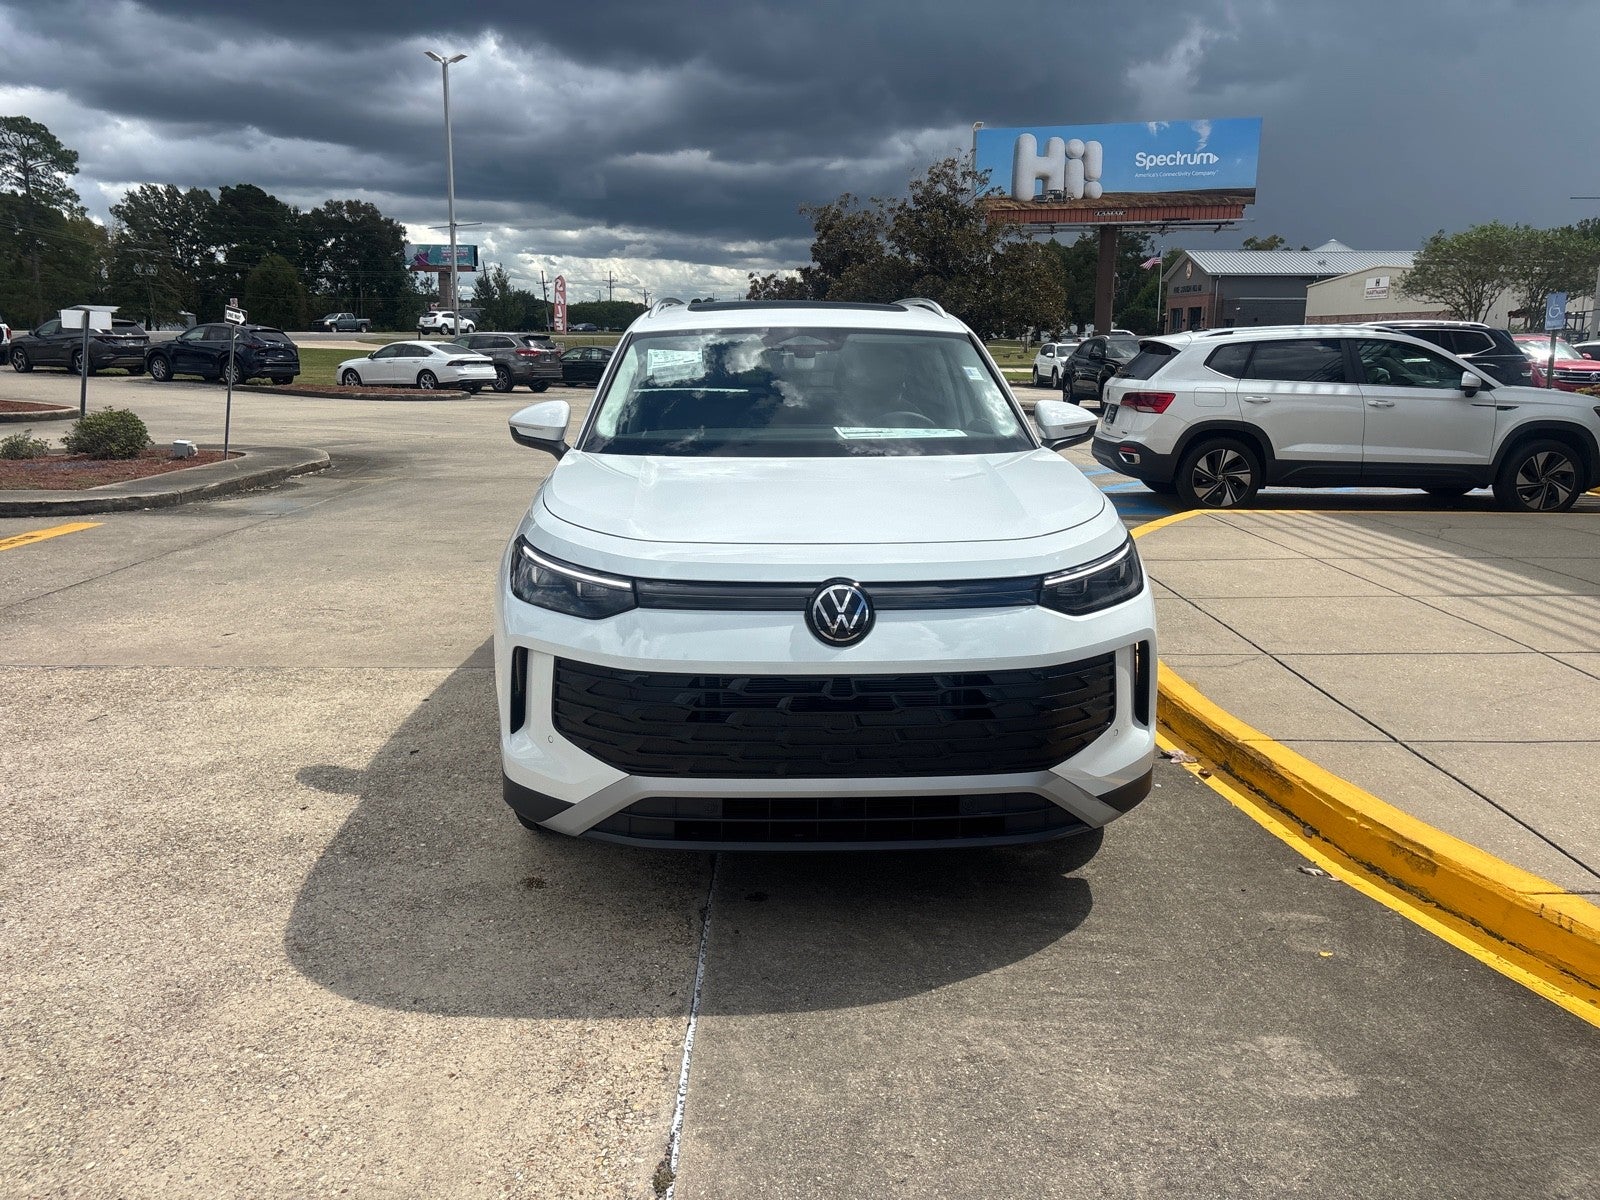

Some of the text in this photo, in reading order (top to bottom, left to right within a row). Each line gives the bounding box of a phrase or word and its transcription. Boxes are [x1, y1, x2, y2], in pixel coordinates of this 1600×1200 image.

[1012, 133, 1102, 201] Hi!
[1135, 151, 1214, 170] Spectrum
[814, 584, 868, 638] VW
